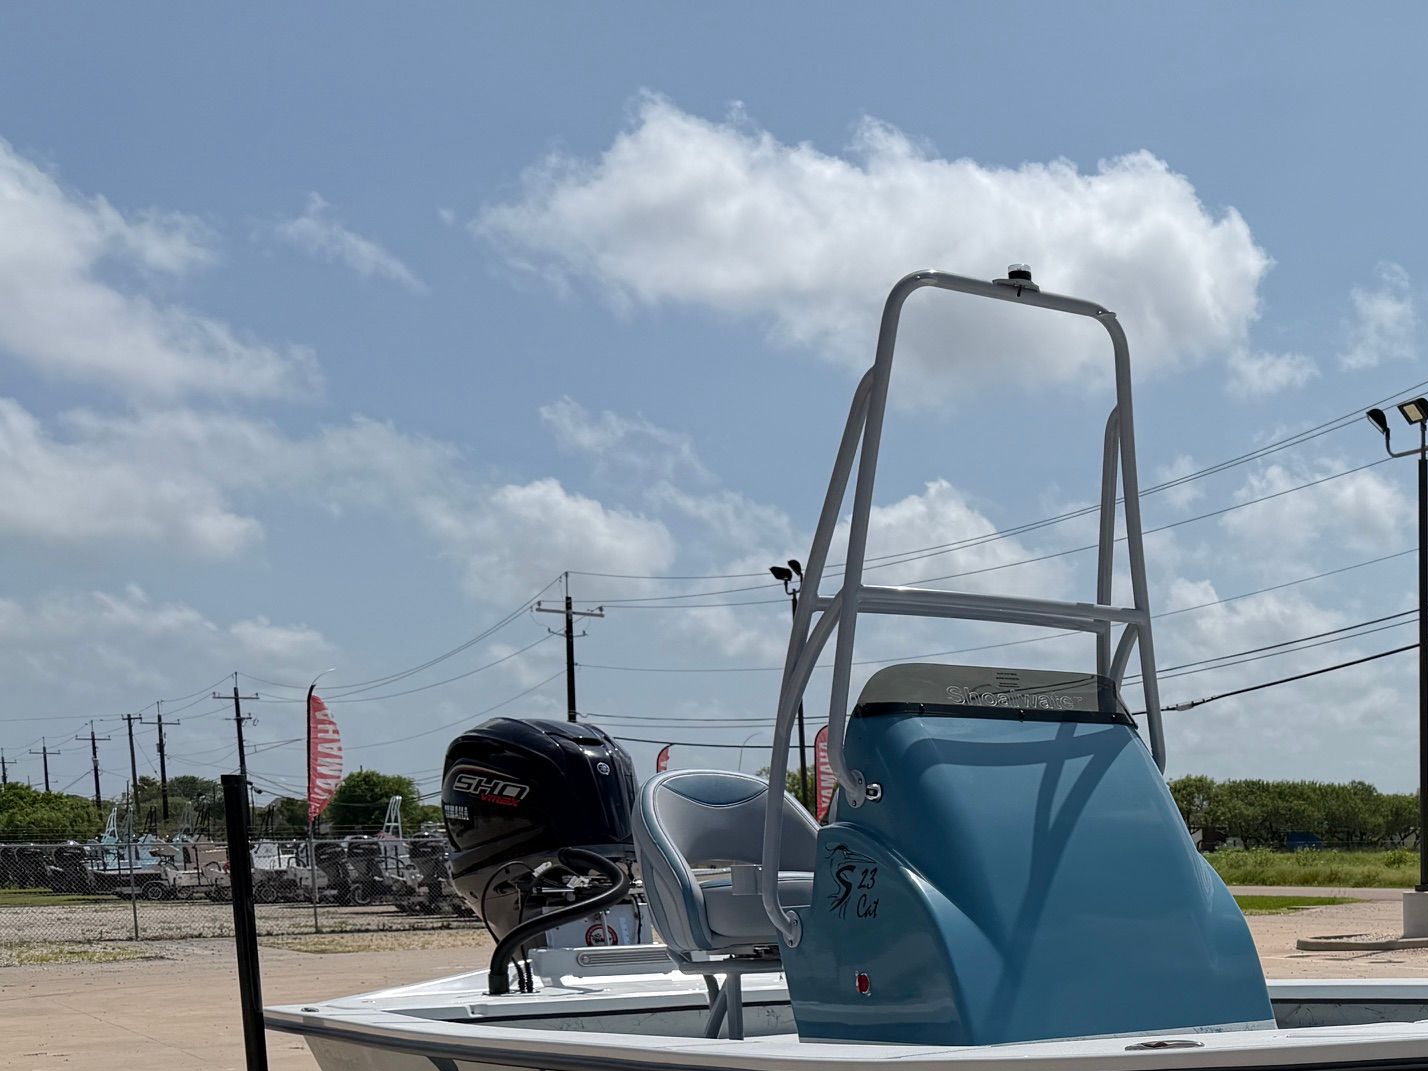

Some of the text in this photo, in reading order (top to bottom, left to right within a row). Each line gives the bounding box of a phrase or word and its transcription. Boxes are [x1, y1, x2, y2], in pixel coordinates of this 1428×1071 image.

[312, 708, 343, 799] YAMAHA
[453, 773, 530, 800] SHO
[857, 867, 878, 890] 23
